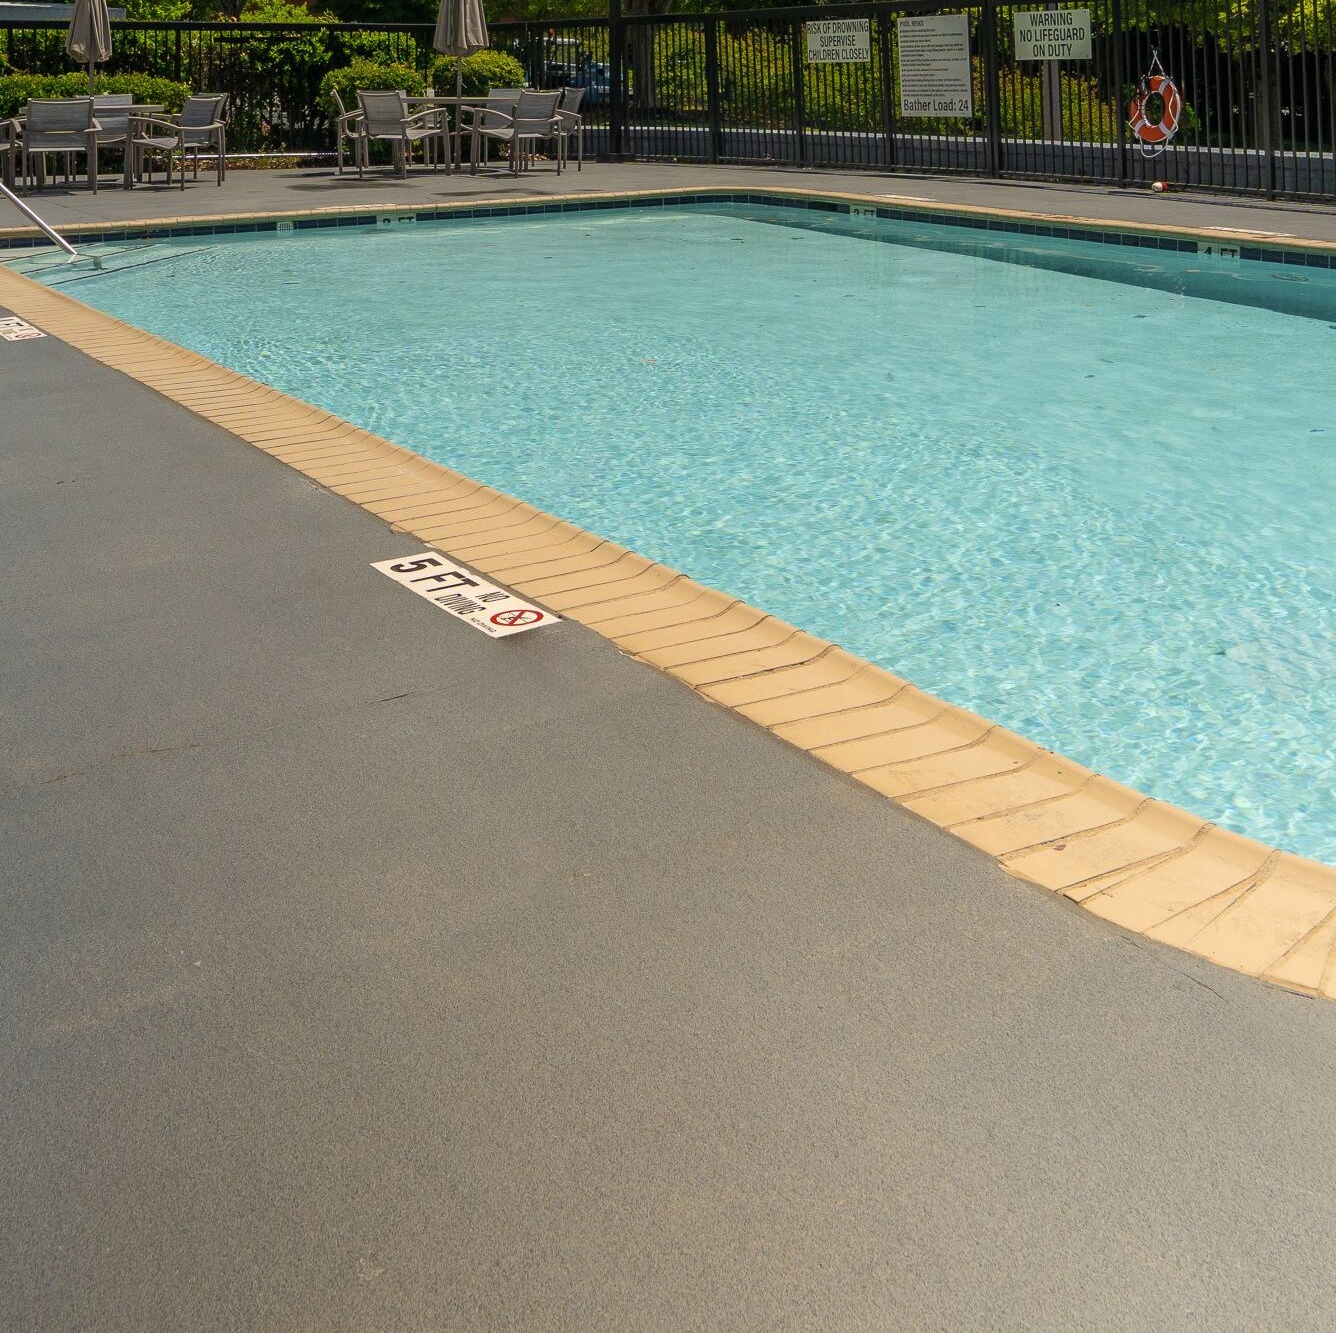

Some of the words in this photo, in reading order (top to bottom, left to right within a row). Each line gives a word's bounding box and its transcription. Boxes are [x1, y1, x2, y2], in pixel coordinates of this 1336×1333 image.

[1029, 12, 1073, 27] WARNING
[807, 22, 821, 35] RISK
[823, 22, 832, 34] OF
[832, 21, 869, 34] DROWNING
[1020, 29, 1032, 43] NO
[1034, 27, 1085, 42] LIFEGUARD
[820, 35, 856, 47] SUPERVISE
[808, 49, 840, 61] CHILDREN
[841, 48, 870, 60] CLOSELY
[1032, 44, 1046, 58] ON
[1047, 43, 1073, 57] DUTY
[903, 98, 931, 112] Bather
[932, 98, 957, 112] Load:
[958, 99, 969, 112] 24
[390, 558, 444, 573] 5
[410, 571, 480, 592] FT
[434, 593, 487, 615] DIVING
[475, 591, 510, 603] NO
